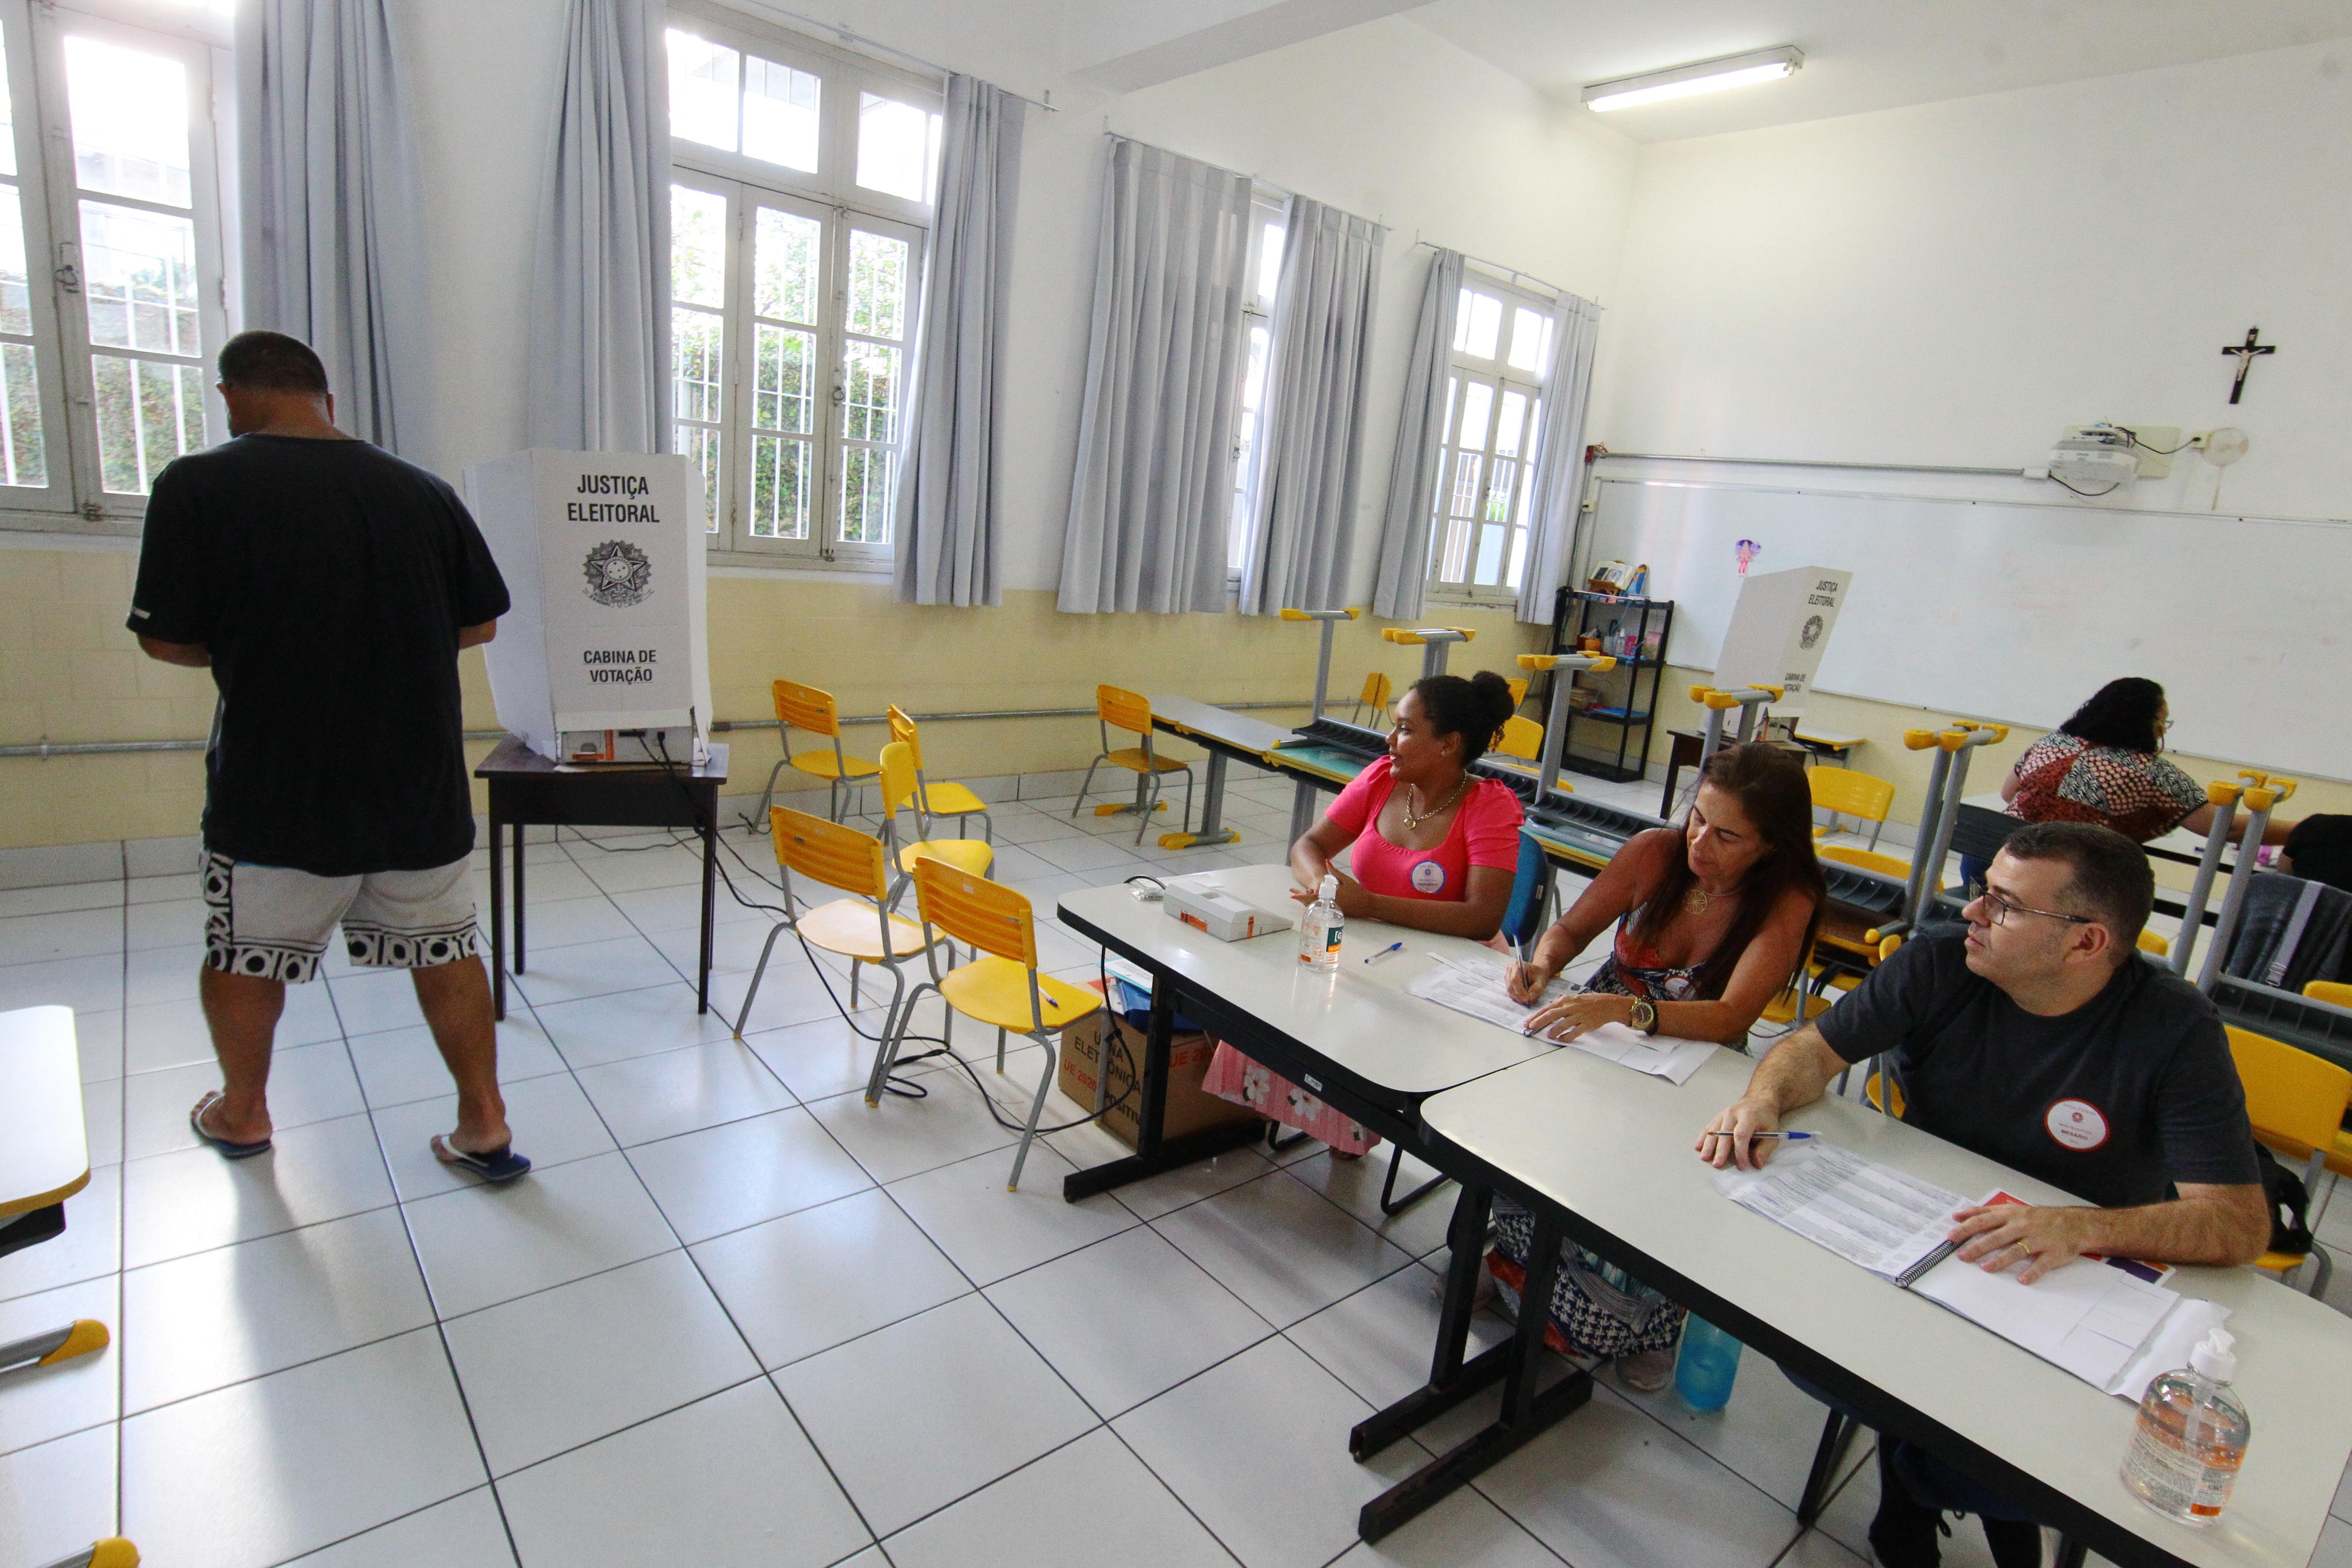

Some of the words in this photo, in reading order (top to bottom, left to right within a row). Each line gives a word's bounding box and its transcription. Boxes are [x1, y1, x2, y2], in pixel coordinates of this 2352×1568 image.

[577, 475, 649, 499] JUSTIÇA
[568, 503, 660, 523] ELEITORAL
[584, 650, 635, 664] CABINA
[639, 650, 656, 662] DE
[589, 667, 652, 685] VOTAÇÃO
[1094, 1030, 1124, 1063] UNA
[1063, 1058, 1075, 1076] UE
[1077, 1070, 1097, 1092] 2020
[1075, 1036, 1141, 1095] ELETÔNICA
